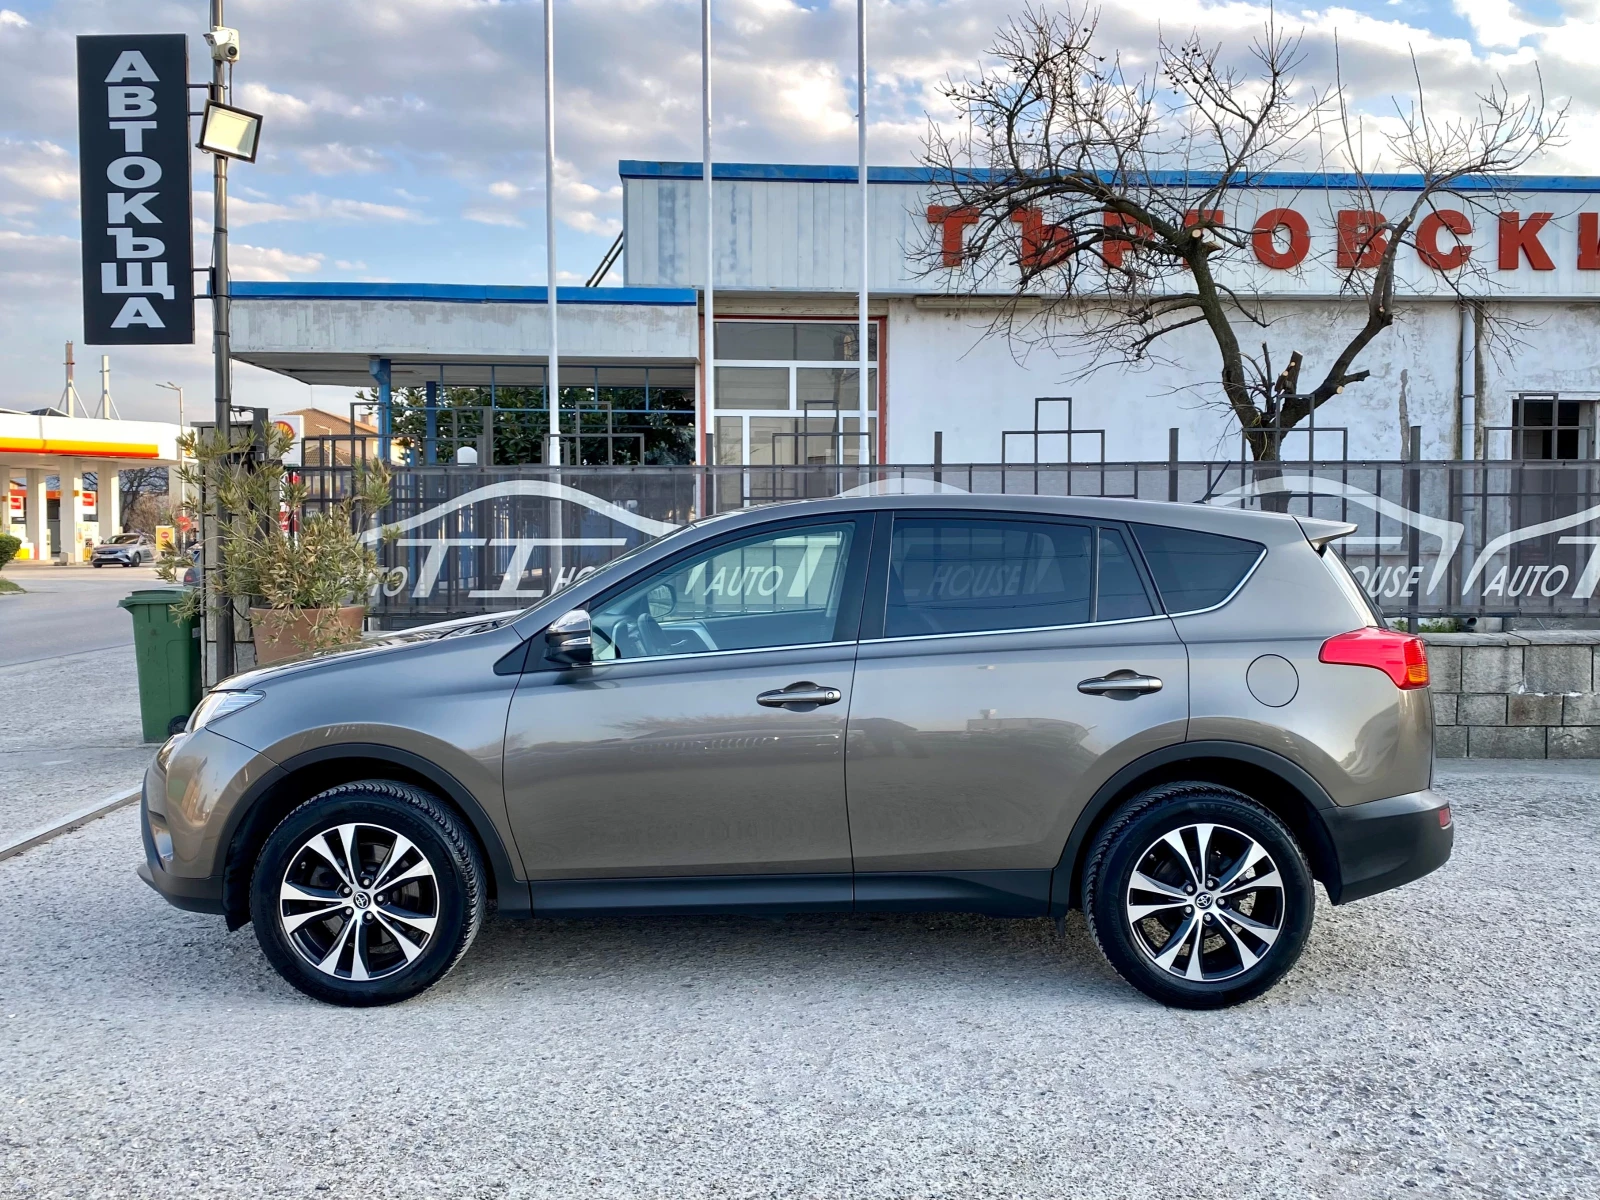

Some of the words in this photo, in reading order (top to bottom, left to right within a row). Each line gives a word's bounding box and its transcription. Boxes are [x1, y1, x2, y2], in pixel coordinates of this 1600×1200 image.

[101, 50, 175, 329] АВТОКЪЩА
[703, 565, 784, 597] AUTO
[926, 565, 1022, 597] HOUSE
[1350, 565, 1425, 598] OUSE
[1481, 564, 1570, 597] AUTO
